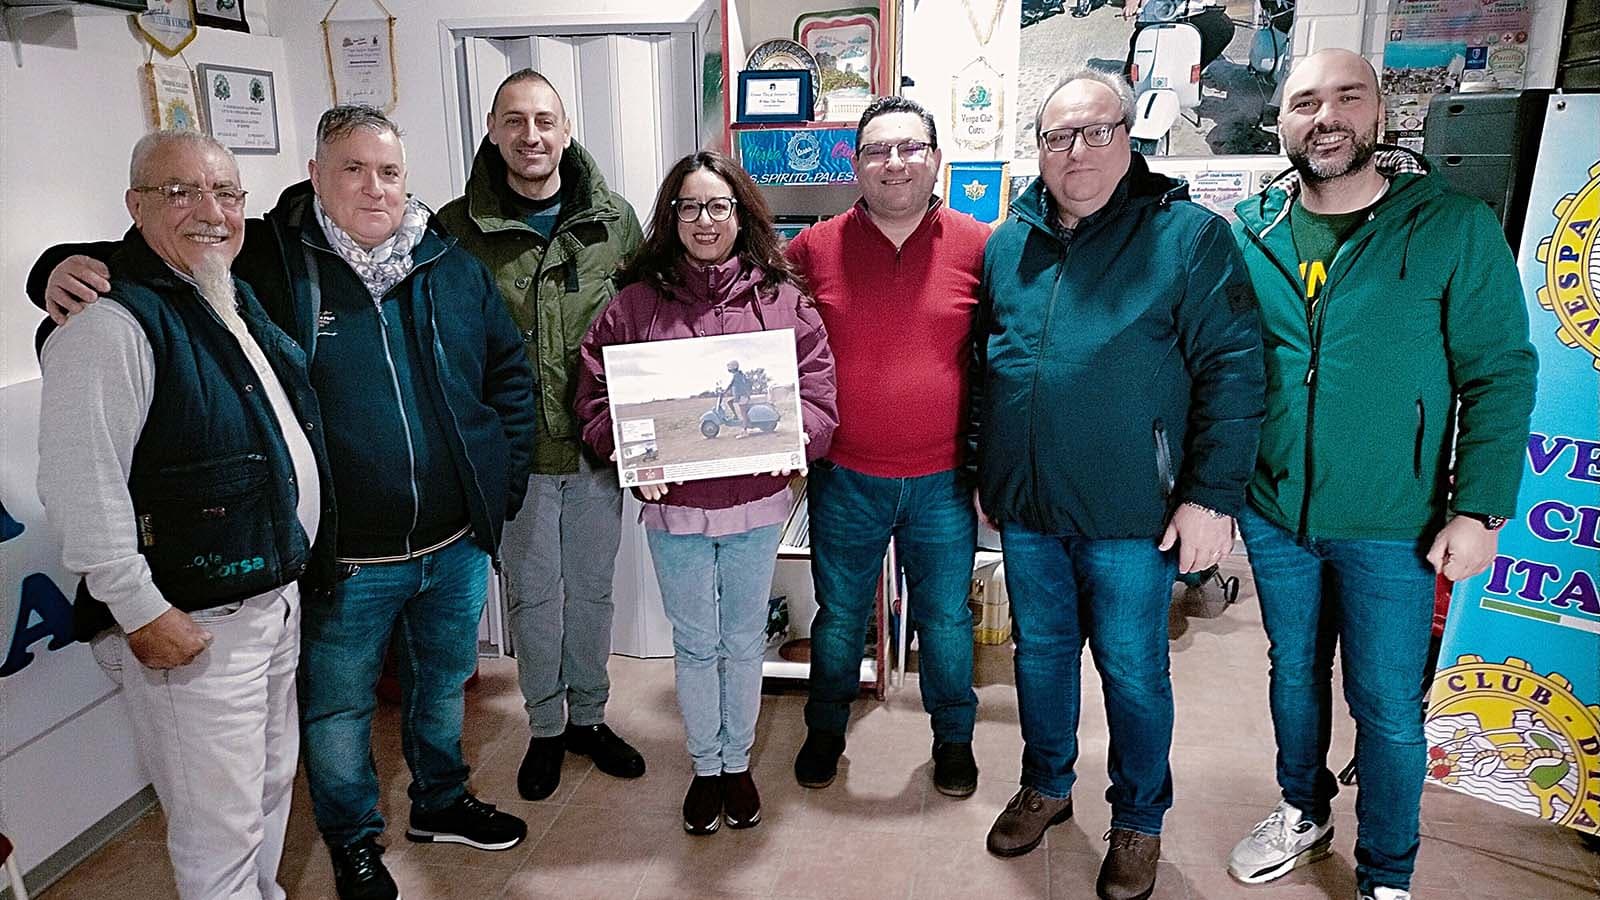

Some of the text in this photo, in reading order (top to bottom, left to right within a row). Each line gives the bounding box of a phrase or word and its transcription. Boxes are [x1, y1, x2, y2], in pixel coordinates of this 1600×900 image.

[980, 113, 994, 122] Club
[746, 144, 782, 161] Vespa
[1558, 218, 1600, 337] VESPA
[1447, 672, 1553, 706] CLUB
